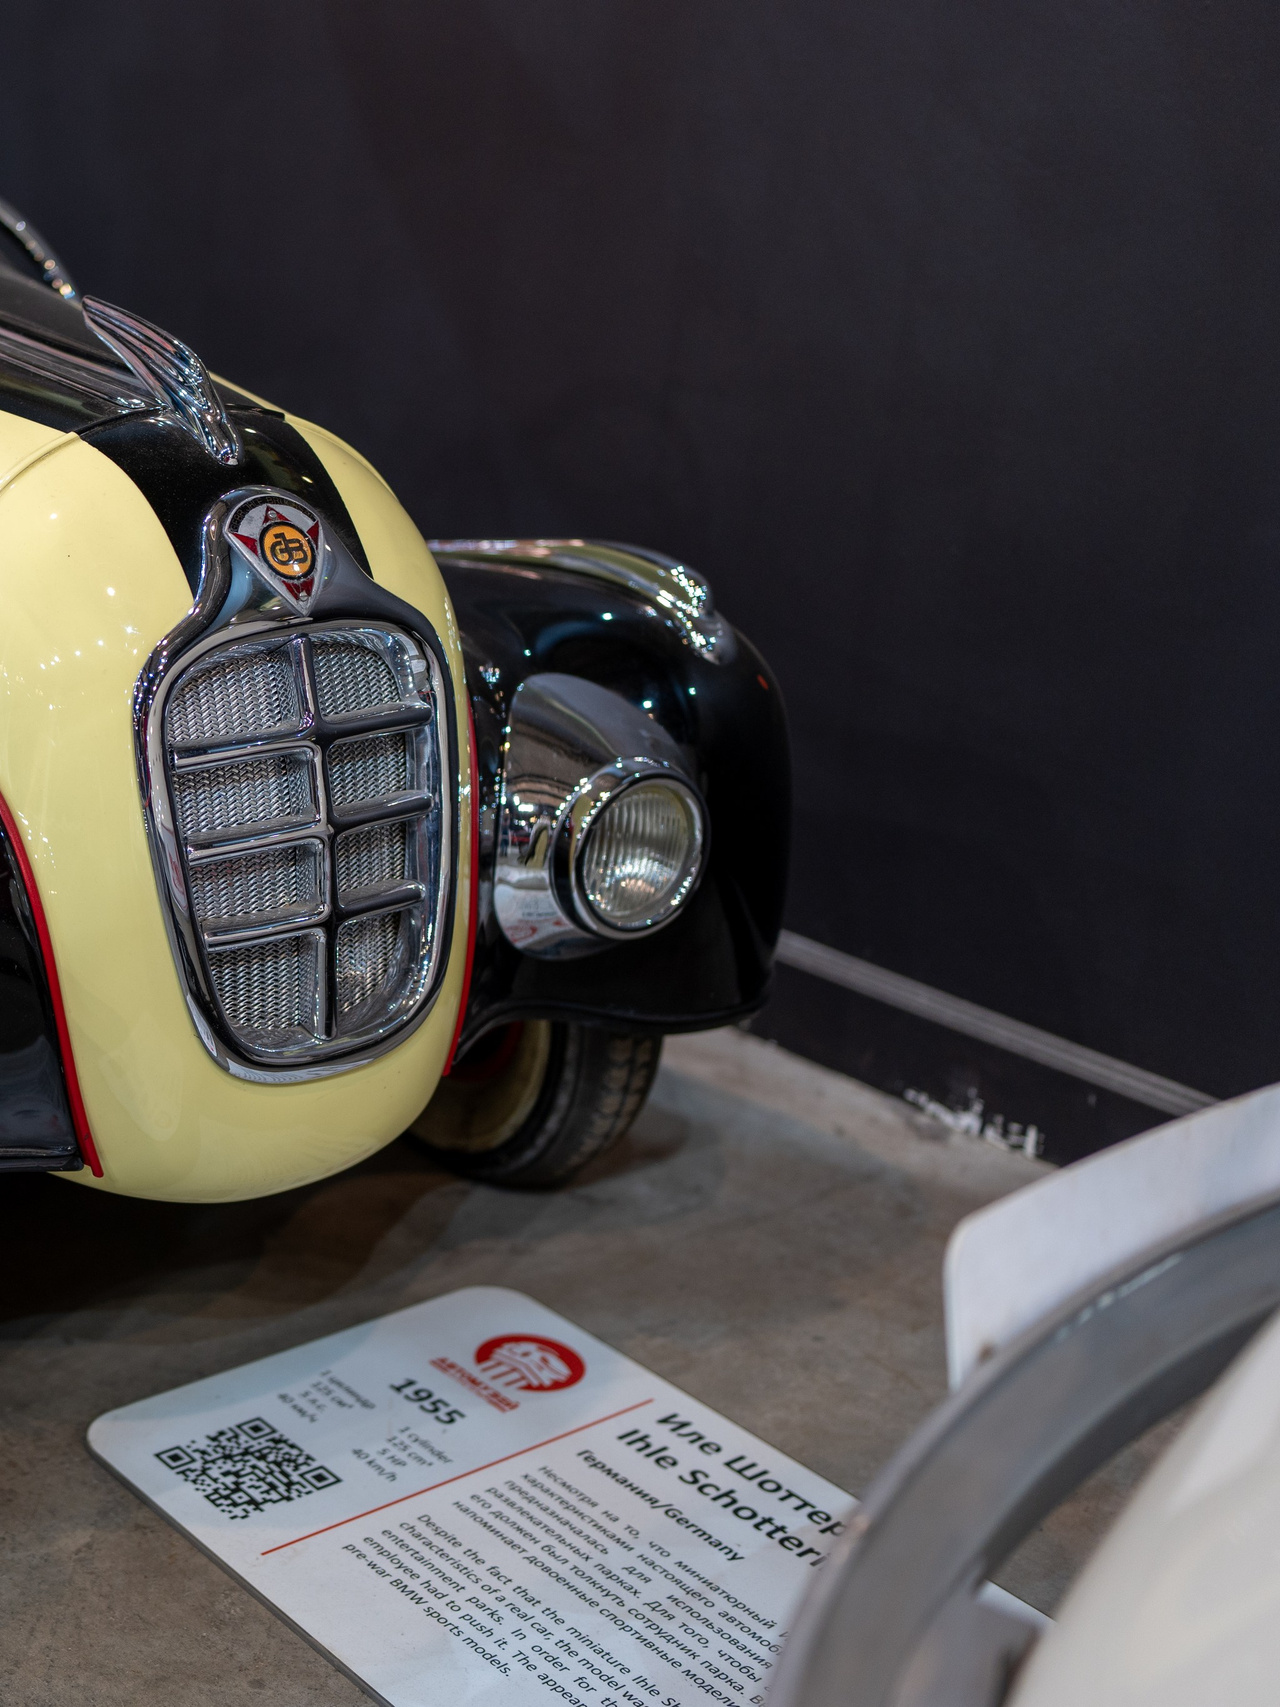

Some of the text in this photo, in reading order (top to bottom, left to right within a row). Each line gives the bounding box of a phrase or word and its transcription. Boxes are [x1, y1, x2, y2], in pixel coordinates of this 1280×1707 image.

[365, 1458, 398, 1483] km/h
[389, 1378, 466, 1425] 1955
[407, 1433, 454, 1464] cylinder
[656, 1412, 844, 1536] Иле Шоттер
[504, 1480, 774, 1670] предназначалась для использования
[521, 1473, 784, 1656] характеристиками настоящего автомоб
[538, 1466, 778, 1630] Несмотря на то, что миниатюрный
[576, 1449, 745, 1562] Германия/Germany
[617, 1428, 830, 1567] Ihle Schotteri
[341, 1543, 512, 1677] pre-war BMW sports models.
[363, 1536, 421, 1580] employee
[419, 1579, 450, 1600] had
[445, 1599, 462, 1613] to
[458, 1613, 494, 1638] push
[493, 1637, 508, 1651] it.
[511, 1649, 538, 1672] The
[381, 1529, 466, 1593] entertainment
[464, 1596, 505, 1626] parks.
[510, 1628, 527, 1641] In
[530, 1644, 571, 1672] order
[572, 1676, 598, 1693] for
[399, 1522, 483, 1585] characteristics
[480, 1584, 502, 1595] of
[494, 1595, 507, 1603] a
[504, 1602, 536, 1622] real
[530, 1621, 555, 1641] car,
[554, 1639, 580, 1658] the
[577, 1657, 627, 1692] model
[417, 1514, 661, 1697] Despite the fact that the miniature Ihle
[452, 1501, 528, 1554] напоминает
[522, 1555, 600, 1608] довоенные
[598, 1608, 683, 1669] спортивные
[470, 1494, 745, 1696] его должен был толкнуть сотрудник парка.
[484, 1487, 763, 1683] развлекательных парках. Для того, чтобы
